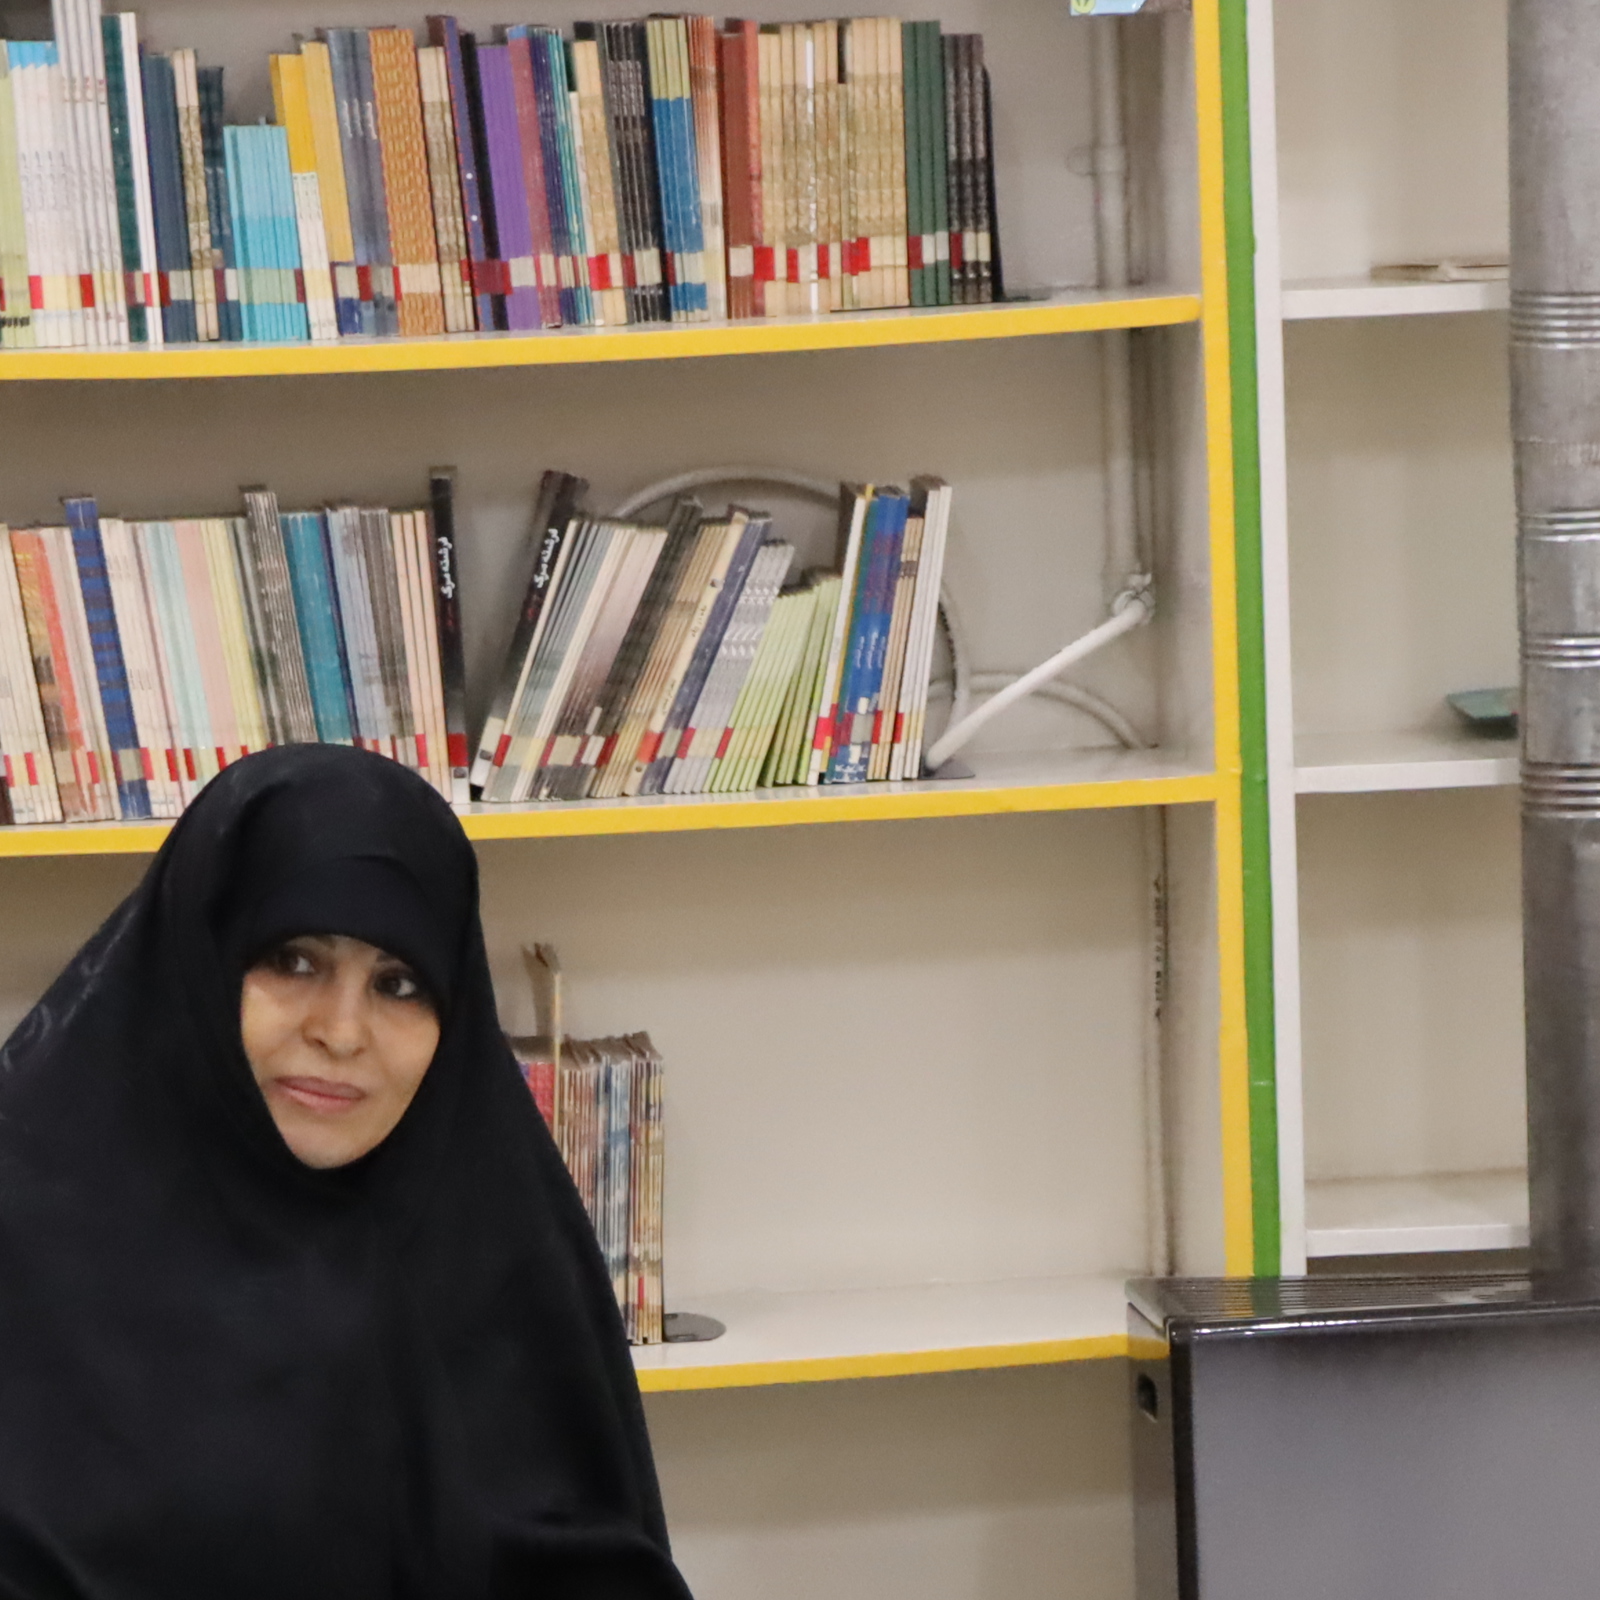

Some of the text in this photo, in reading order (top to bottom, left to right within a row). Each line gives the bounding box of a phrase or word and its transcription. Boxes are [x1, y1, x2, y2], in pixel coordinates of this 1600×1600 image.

[438, 536, 455, 599] فرشته مرگ
[533, 528, 560, 588] فرشته مرگ
